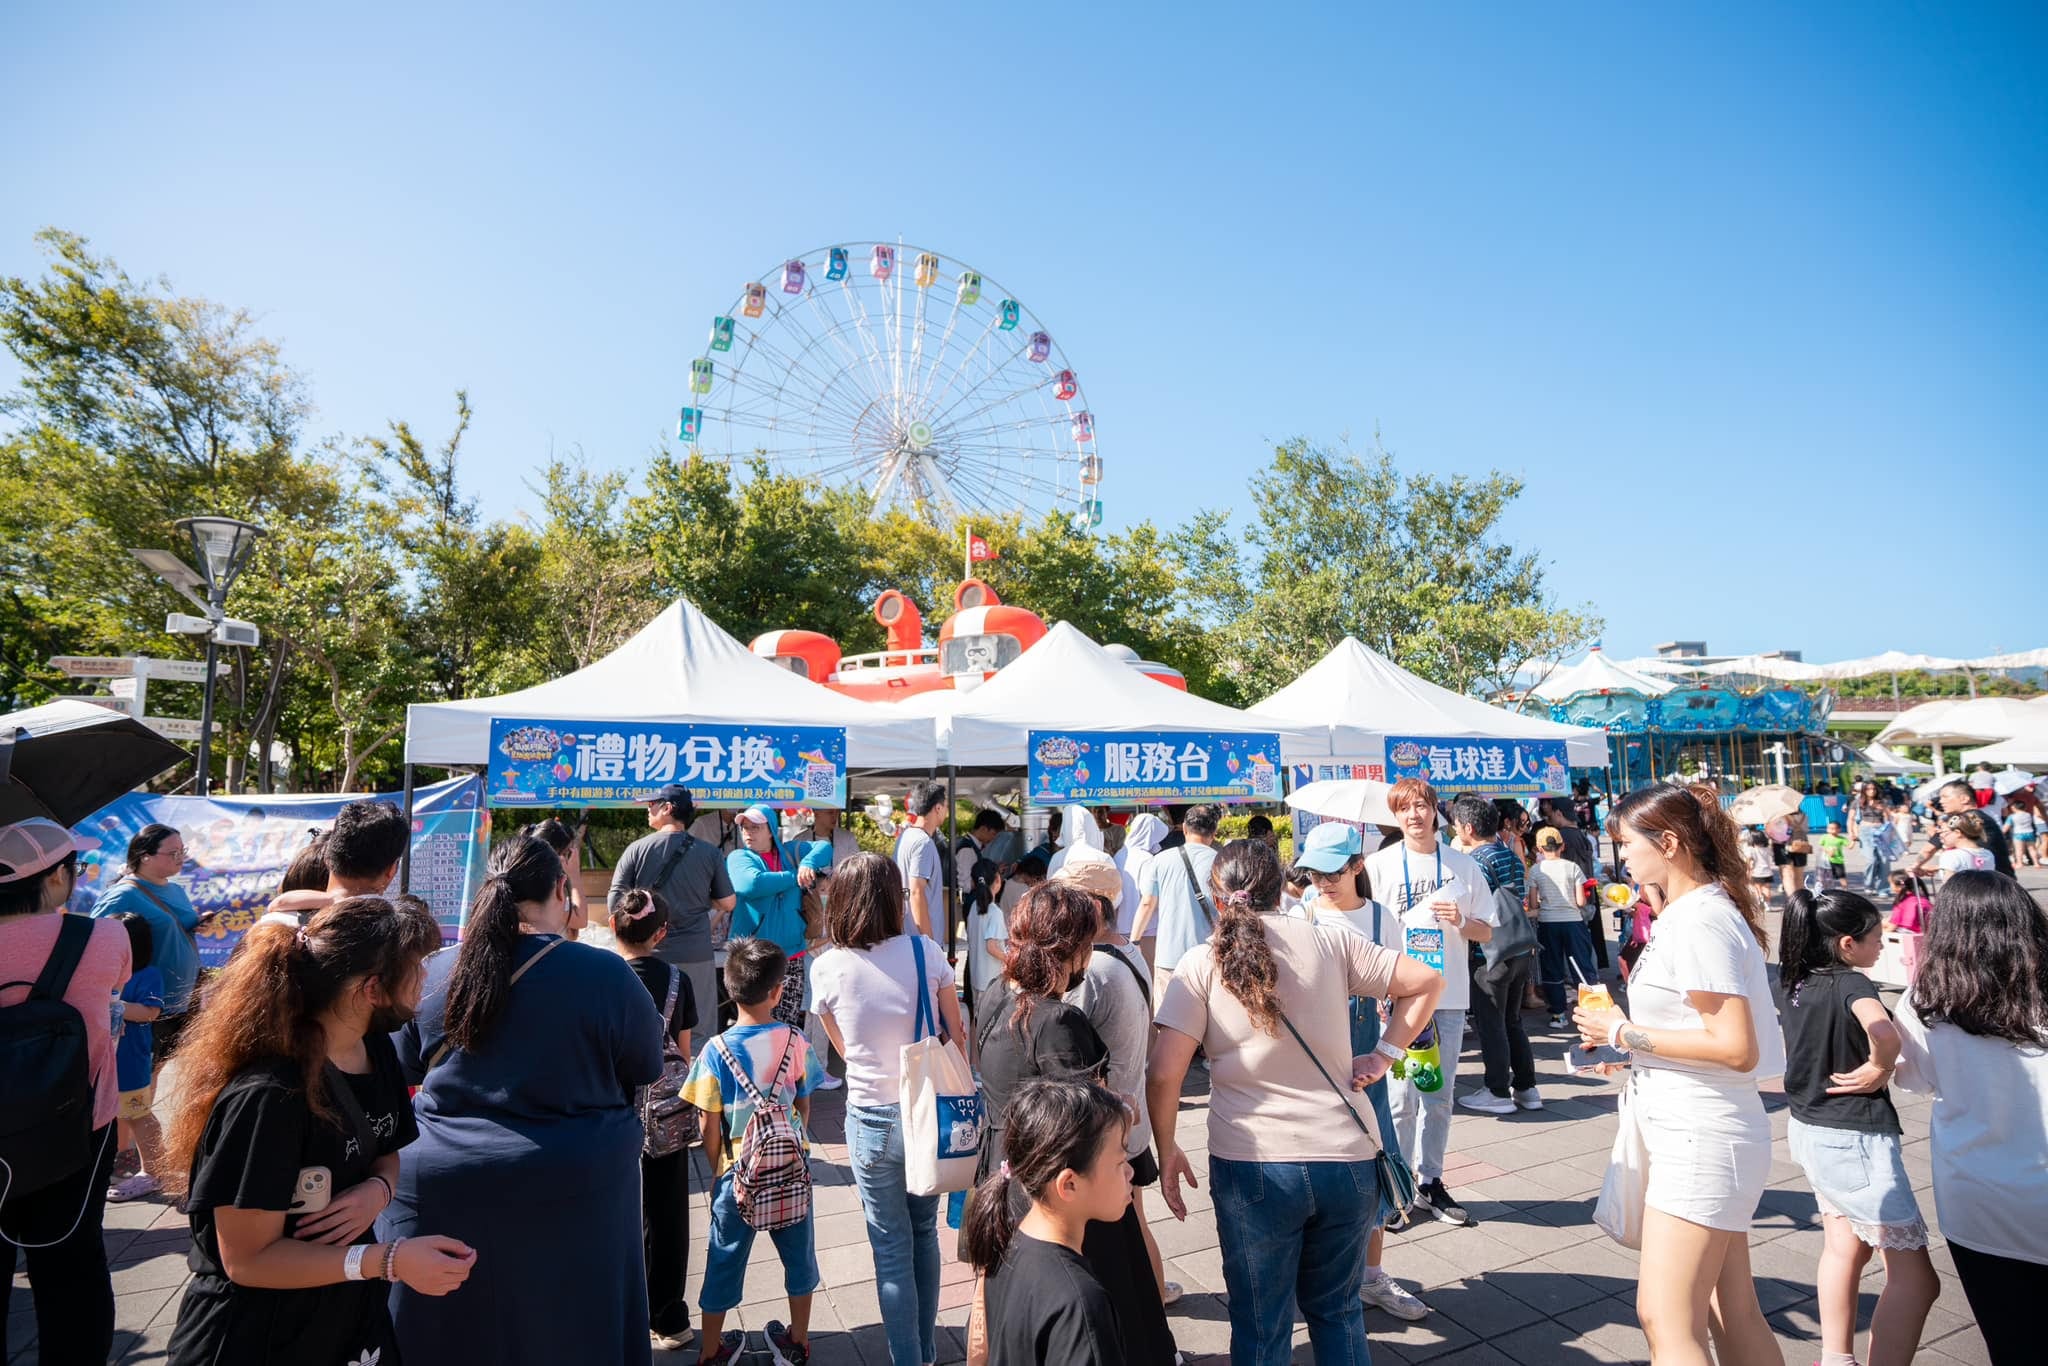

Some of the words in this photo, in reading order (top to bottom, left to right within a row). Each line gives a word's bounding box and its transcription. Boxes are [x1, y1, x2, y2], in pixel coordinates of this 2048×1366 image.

[574, 733, 776, 783] 禮物兌換
[1104, 742, 1210, 783] 服務台
[1428, 745, 1532, 781] 氣球達人
